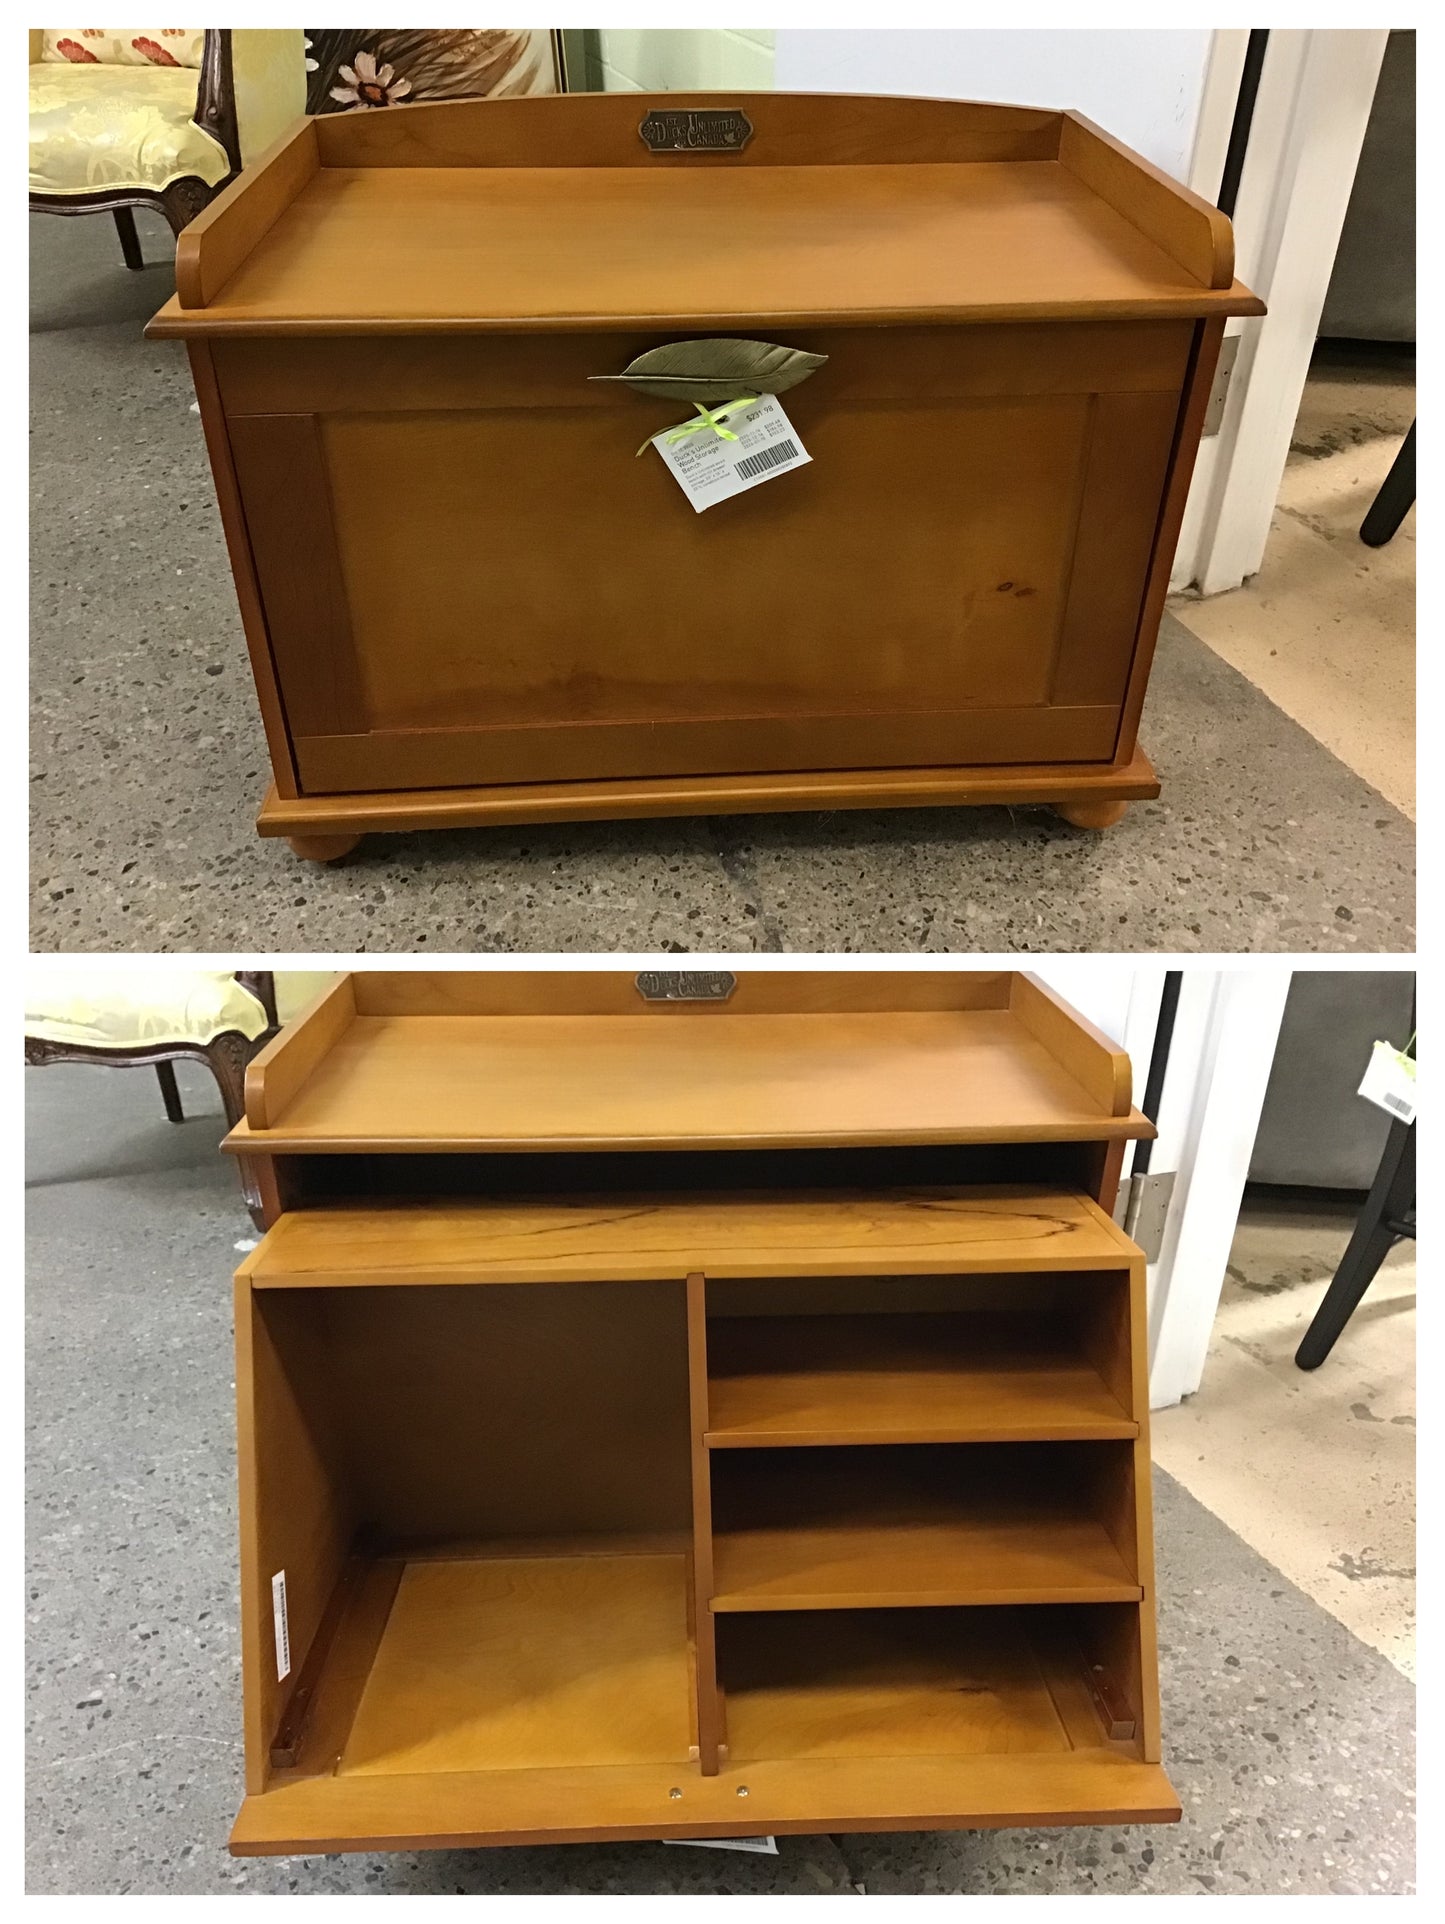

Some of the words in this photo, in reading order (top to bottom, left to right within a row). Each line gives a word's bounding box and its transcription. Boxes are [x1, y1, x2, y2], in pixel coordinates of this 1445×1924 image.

[688, 114, 736, 134] UNLIMITED
[687, 126, 726, 146] CANADA
[745, 404, 774, 422] $231.98
[695, 436, 724, 451] Unlimite
[677, 456, 695, 468] Wood
[694, 446, 720, 461] Storage
[681, 462, 701, 474] Bench
